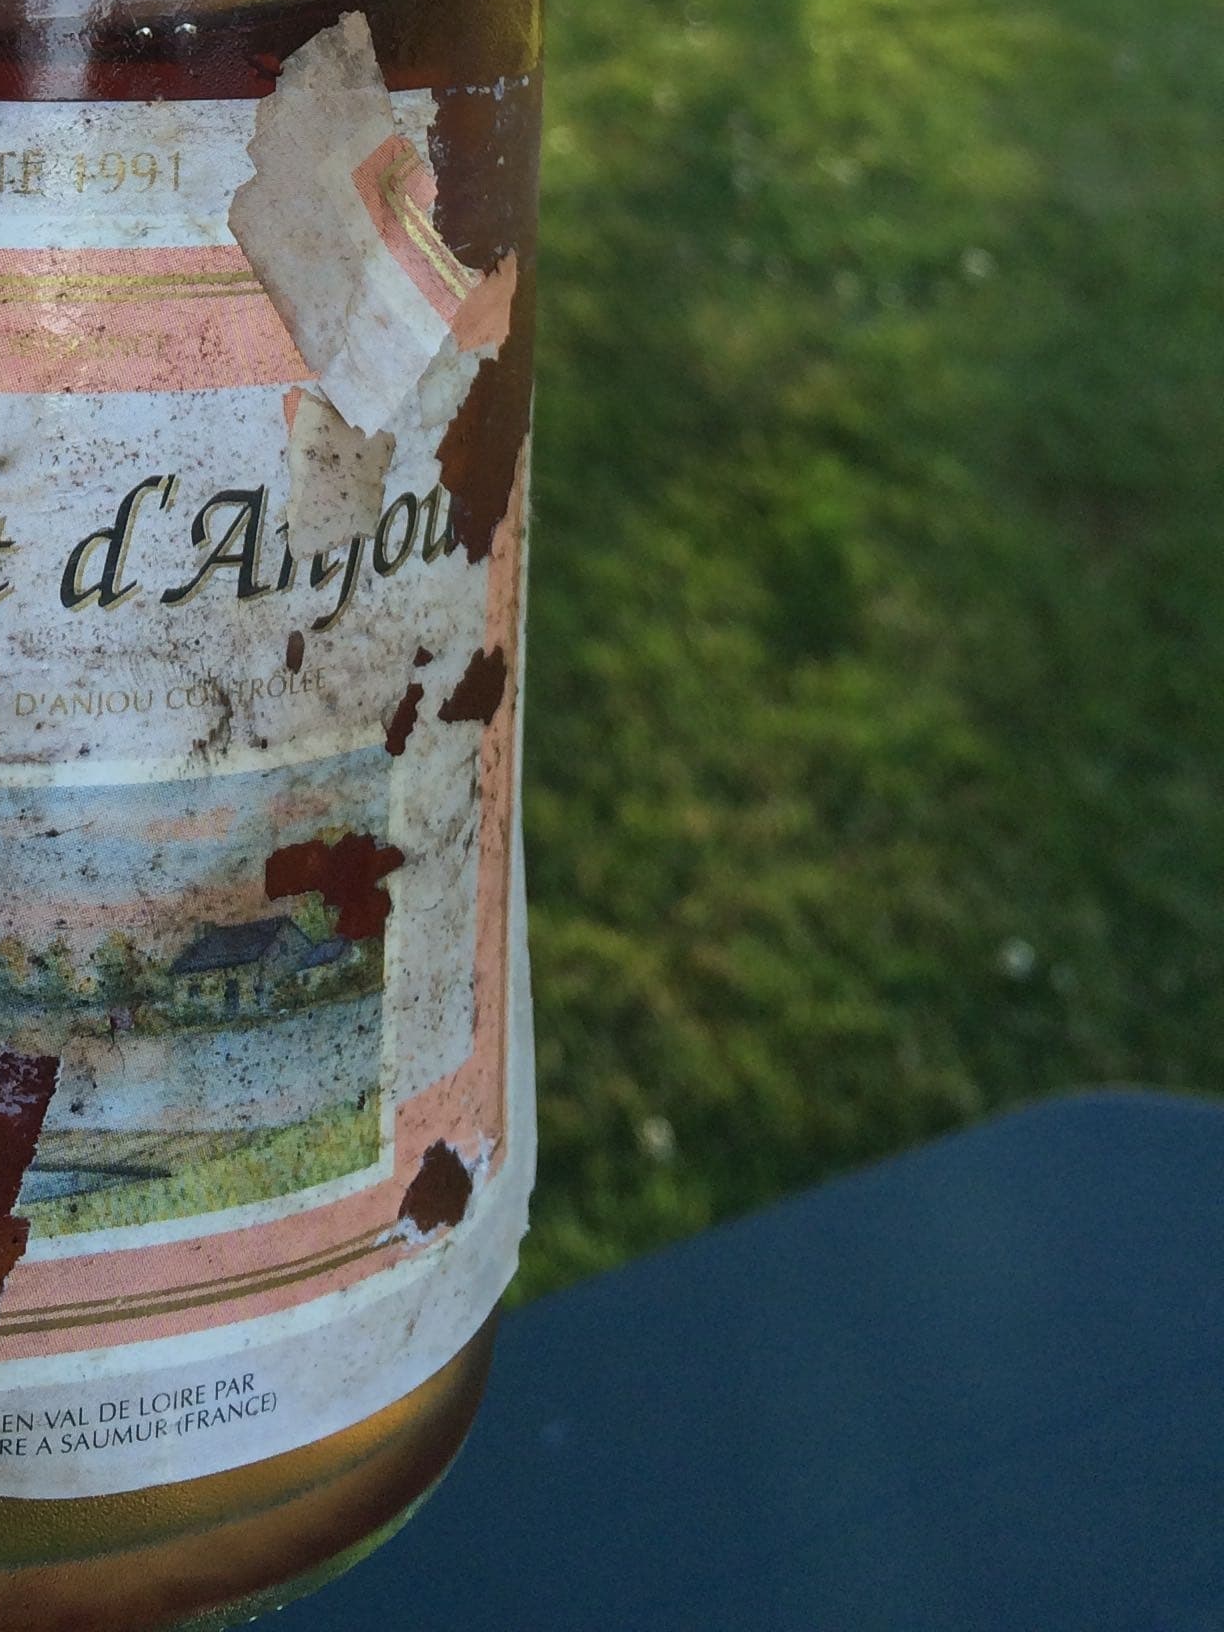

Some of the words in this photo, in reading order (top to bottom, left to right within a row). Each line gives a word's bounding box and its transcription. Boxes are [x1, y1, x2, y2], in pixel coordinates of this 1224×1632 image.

[74, 149, 181, 195] 1991
[15, 688, 153, 717] D'ANJOU
[2, 1412, 34, 1433] EN
[44, 1406, 89, 1429] VAL
[99, 1399, 130, 1424] DE
[139, 1385, 206, 1417] LOIRE
[214, 1372, 255, 1401] PAR
[35, 1436, 53, 1456] A
[60, 1418, 169, 1454] SAUMUR
[176, 1391, 278, 1438] (FRANCE)
